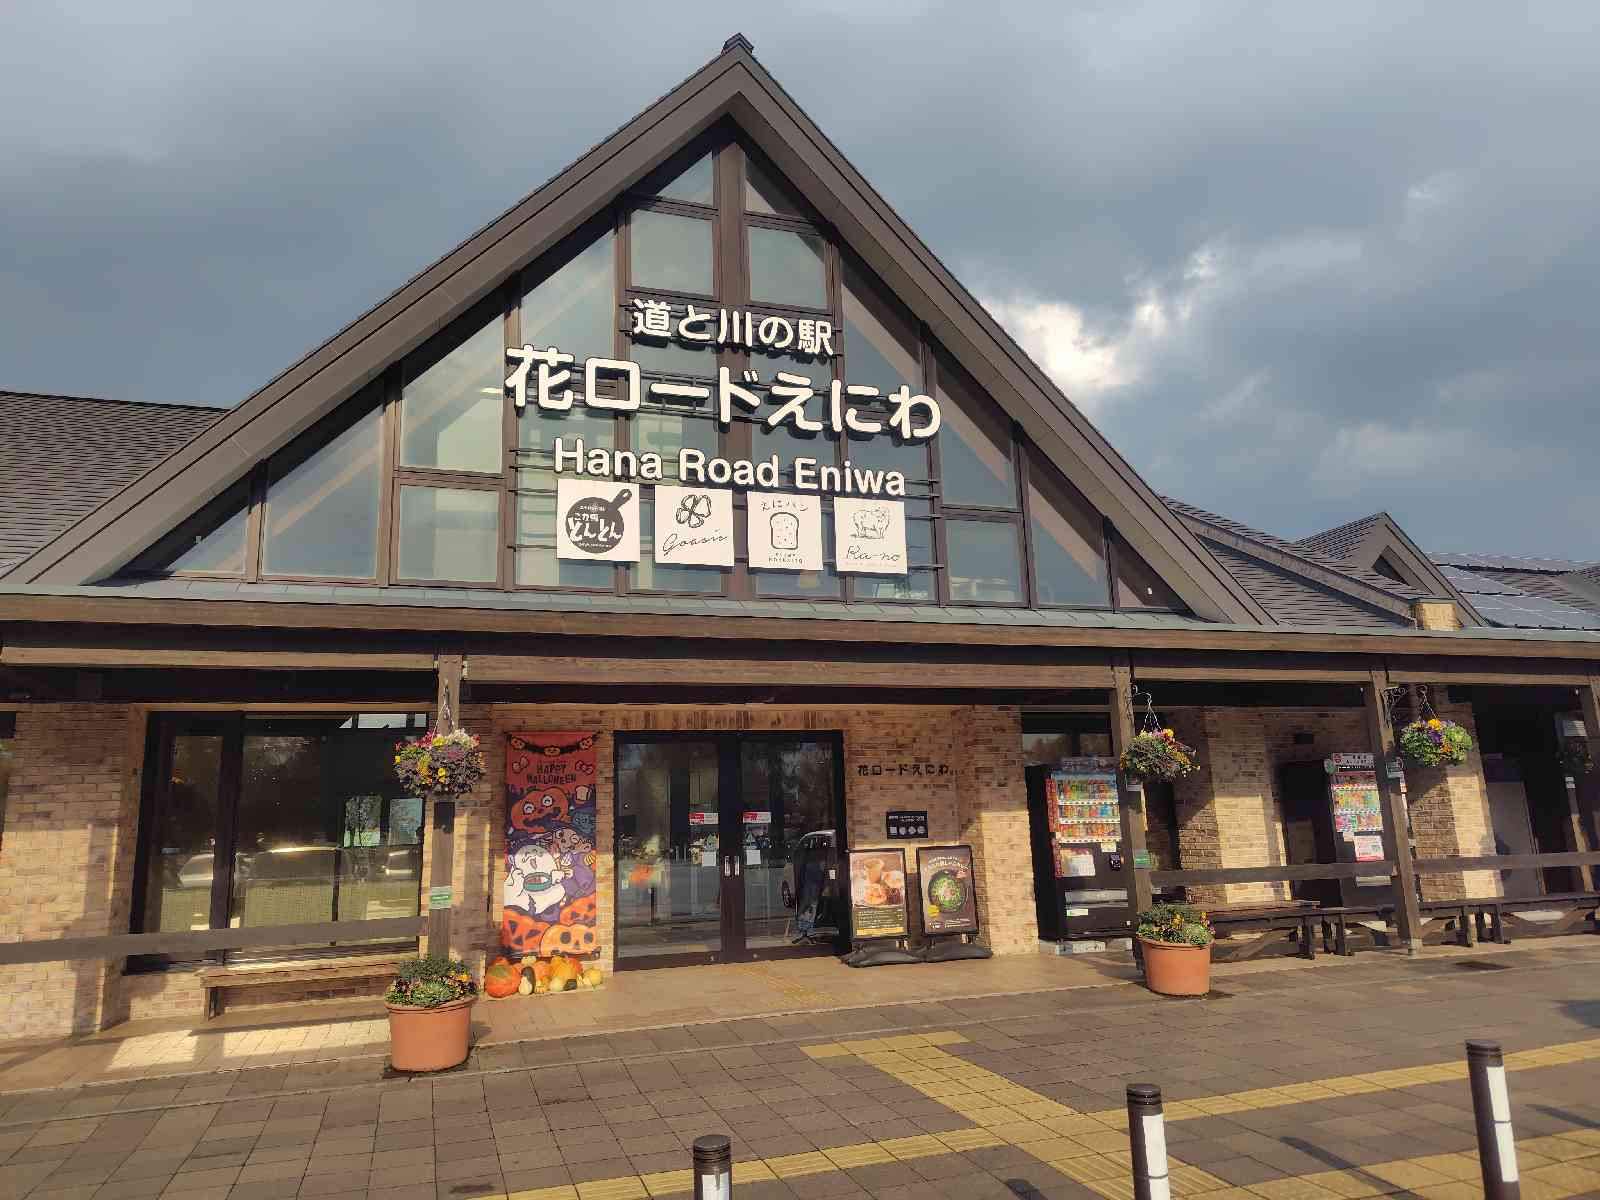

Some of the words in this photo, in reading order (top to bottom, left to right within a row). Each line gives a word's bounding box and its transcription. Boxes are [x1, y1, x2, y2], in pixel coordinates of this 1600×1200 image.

[632, 298, 834, 356] 道と川の駅
[504, 344, 942, 440] 花ロードえにわ
[554, 437, 663, 480] Hana
[679, 447, 780, 489] Road
[794, 457, 906, 496] Eniwa
[527, 773, 576, 785] HALLOWEEN
[536, 762, 567, 774] HAPPY
[857, 763, 949, 776] 花ロードえにわ
